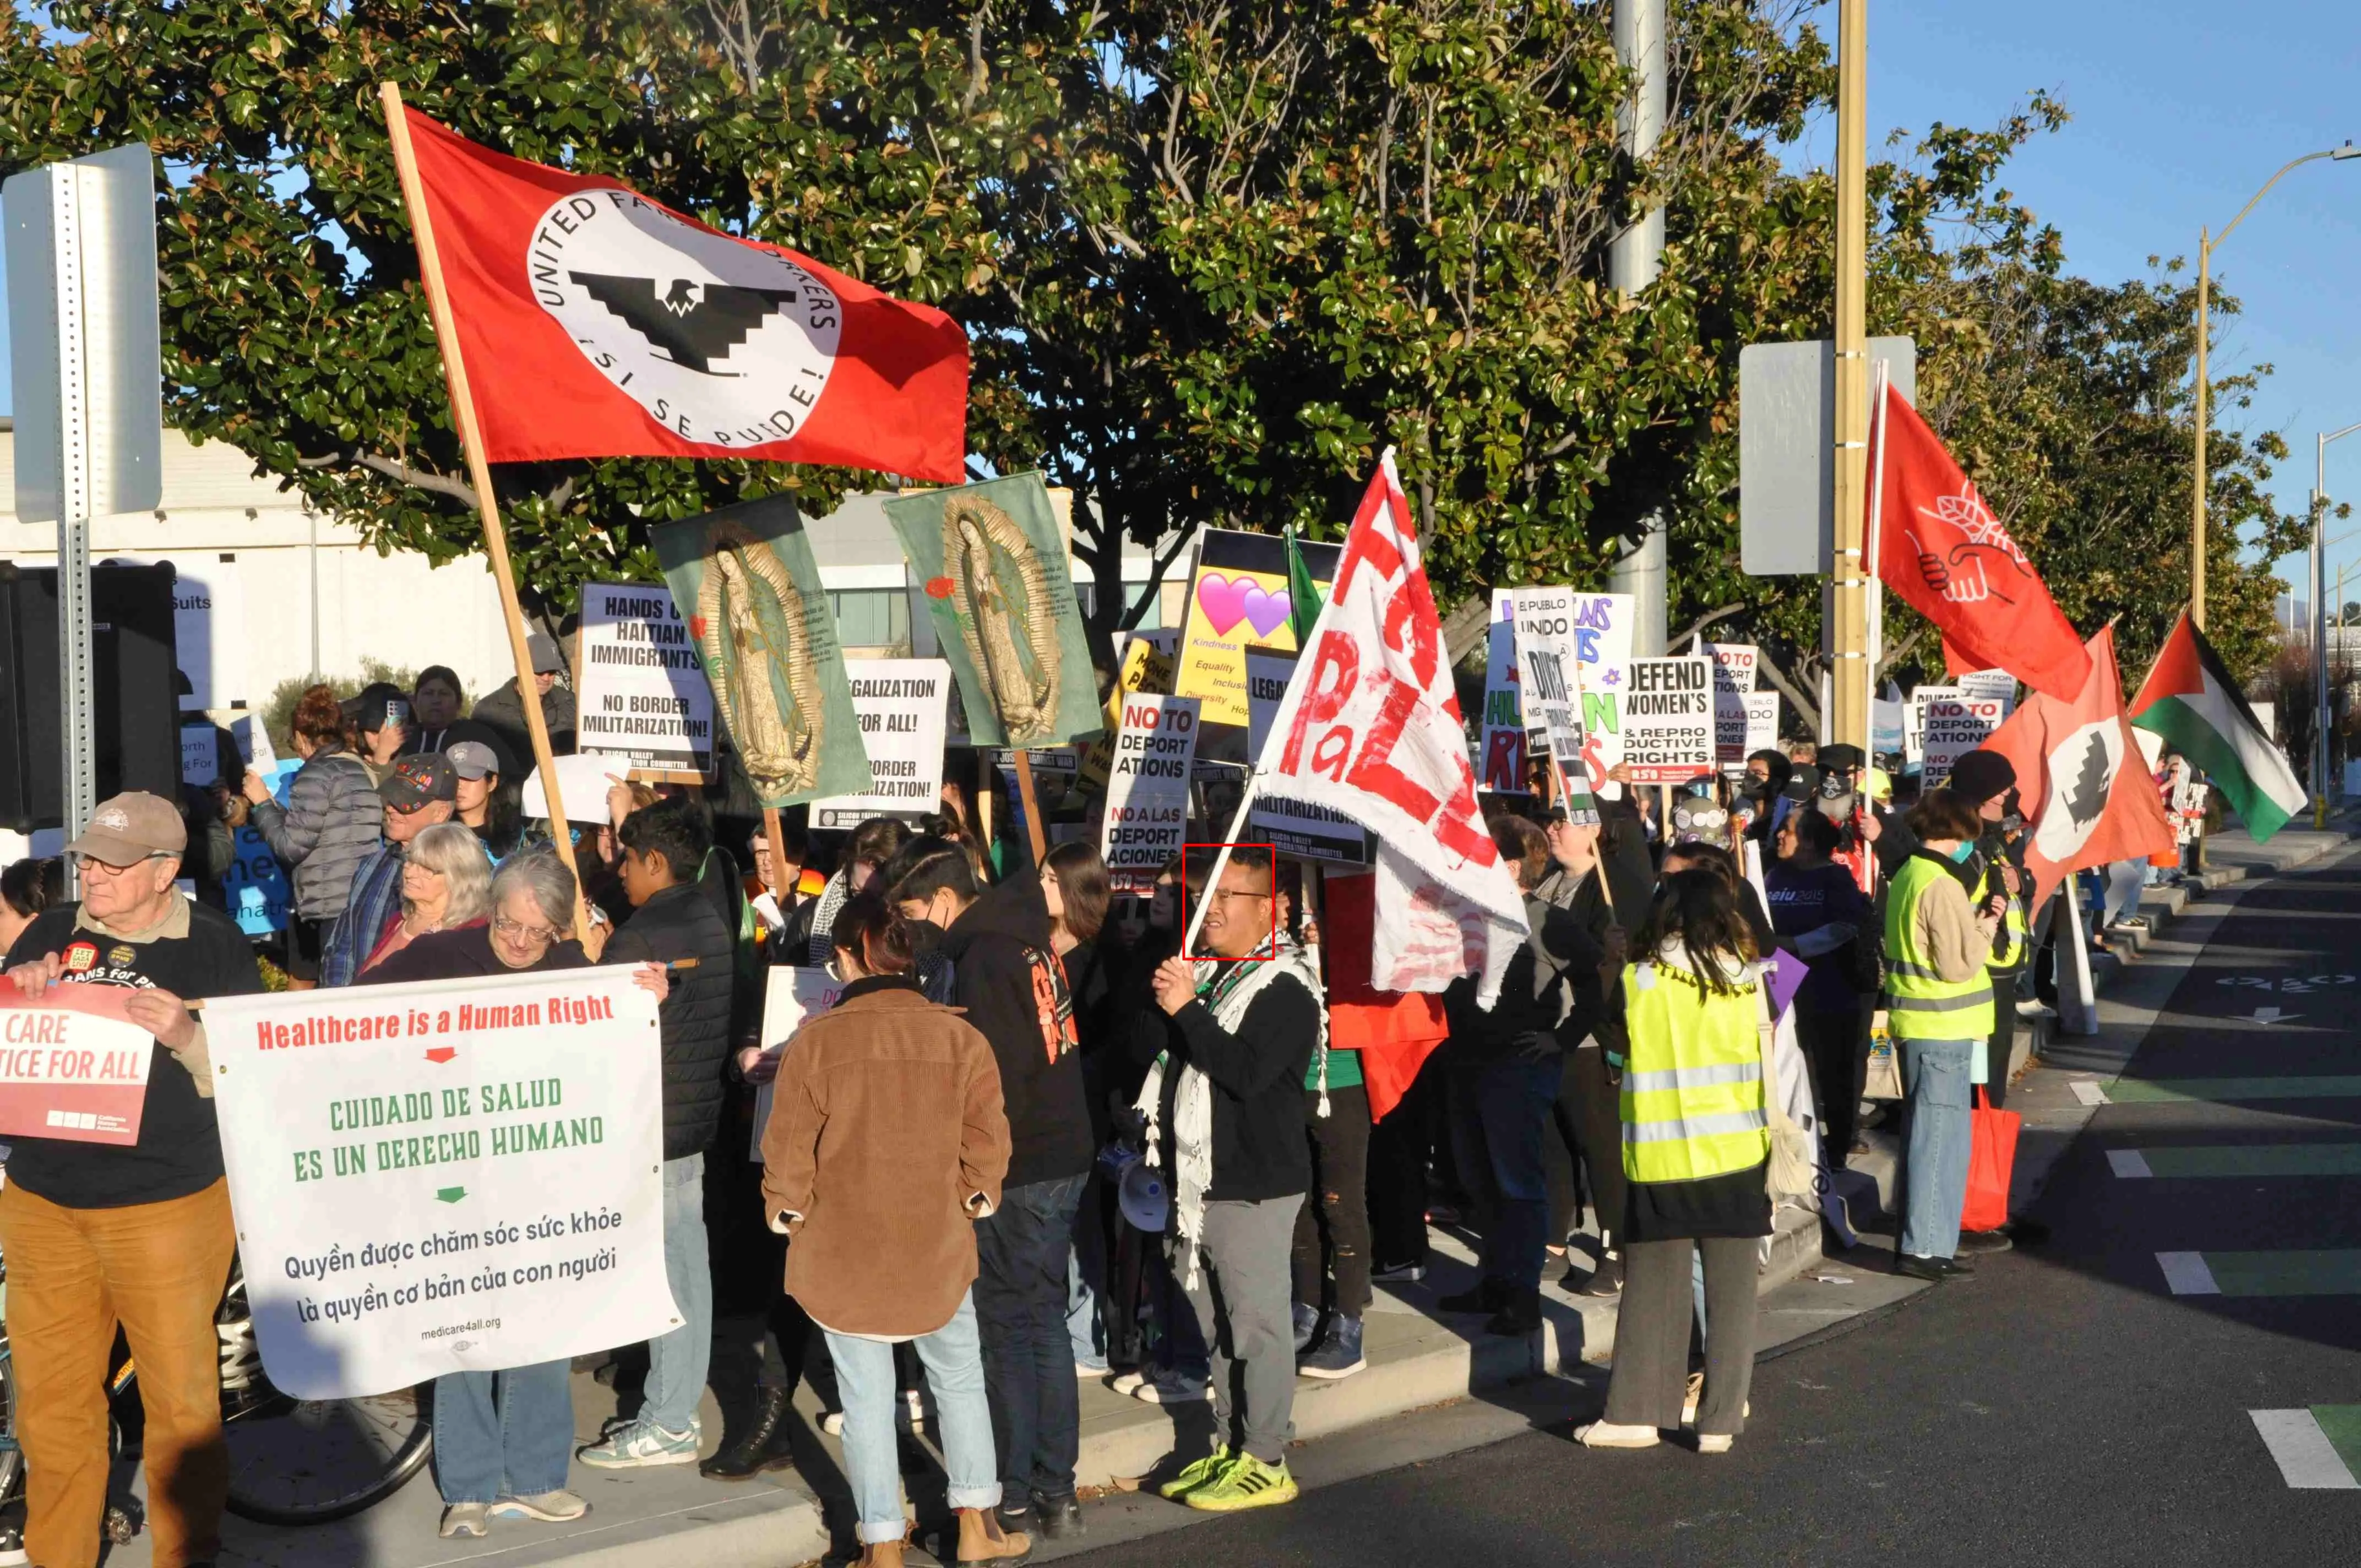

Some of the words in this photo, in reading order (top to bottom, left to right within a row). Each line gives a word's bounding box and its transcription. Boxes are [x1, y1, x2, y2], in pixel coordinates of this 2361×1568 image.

[534, 196, 596, 307] UNITED
[654, 399, 691, 439] SE
[605, 596, 663, 619] HANDS
[1528, 598, 1566, 611] PUEBLO
[617, 622, 686, 645] HAITIAN
[1192, 637, 1238, 651] Kindness
[591, 645, 701, 670] IMMIGRANTS
[1707, 650, 1731, 665] NO
[1733, 652, 1753, 667] TO
[1195, 660, 1235, 674] Equality
[1714, 668, 1750, 680] EPORT
[850, 679, 935, 698] GALIZATION
[1212, 678, 1247, 689] Inclusi
[1713, 681, 1749, 694] TIONS
[603, 694, 623, 712] NO
[630, 695, 689, 715] BORDER
[1185, 690, 1228, 705] Diversity
[1231, 705, 1250, 716] Hop
[1726, 710, 1746, 720] LAS
[1930, 704, 1963, 717] NO
[1967, 703, 1997, 716] TO
[583, 715, 709, 738] MILITARIZATION!
[886, 714, 918, 733] ALL!
[1125, 705, 1161, 729] NO
[1165, 709, 1193, 733] TO
[1929, 720, 1995, 729] DEPORT
[1625, 728, 1635, 738] &
[1641, 727, 1706, 738] REPRO
[1715, 722, 1746, 733] PORT
[1121, 734, 1189, 754] DEPORT
[1624, 738, 1706, 749] DUCTIVE
[1716, 734, 1745, 743] ONES
[182, 741, 205, 753] orth
[630, 751, 654, 760] VALLEY
[999, 752, 1015, 763] JOS
[1056, 756, 1074, 767] WAR
[1927, 754, 1949, 764] NO
[193, 759, 212, 769] For
[650, 760, 688, 769] COMMITTEE
[1117, 756, 1184, 778] ATIONS
[1111, 807, 1135, 822] NO
[1137, 808, 1149, 821] A
[1151, 808, 1181, 823] LAS
[1108, 827, 1180, 845] DEPORT
[110, 968, 136, 980] for
[6, 1013, 70, 1044] CARE
[256, 1015, 400, 1050] Healthcare
[407, 1009, 430, 1036] is
[437, 1010, 451, 1033] a
[458, 1002, 541, 1032] Human
[548, 995, 614, 1025] Right
[47, 1049, 95, 1079] FOR
[99, 1050, 140, 1079] ALL
[330, 1090, 433, 1131] CUIDADO
[442, 1087, 471, 1118] DE
[480, 1077, 562, 1113] SALUD
[292, 1150, 324, 1183] ES
[333, 1144, 367, 1177] UN
[376, 1129, 481, 1171] DERECHO
[489, 1115, 604, 1156] HUMANO
[285, 1243, 355, 1282] Quyền
[361, 1241, 414, 1269] được
[421, 1229, 479, 1257] chăm
[483, 1221, 520, 1247] sóc
[526, 1214, 565, 1240] sức
[570, 1206, 622, 1234] khỏe
[296, 1297, 320, 1323] là
[324, 1282, 389, 1324] quyền
[394, 1283, 419, 1306] cơ
[425, 1273, 465, 1301] bản
[471, 1266, 507, 1293] của
[513, 1264, 552, 1285] con
[558, 1246, 617, 1281] người
[421, 1317, 501, 1341] medicare4all.org
